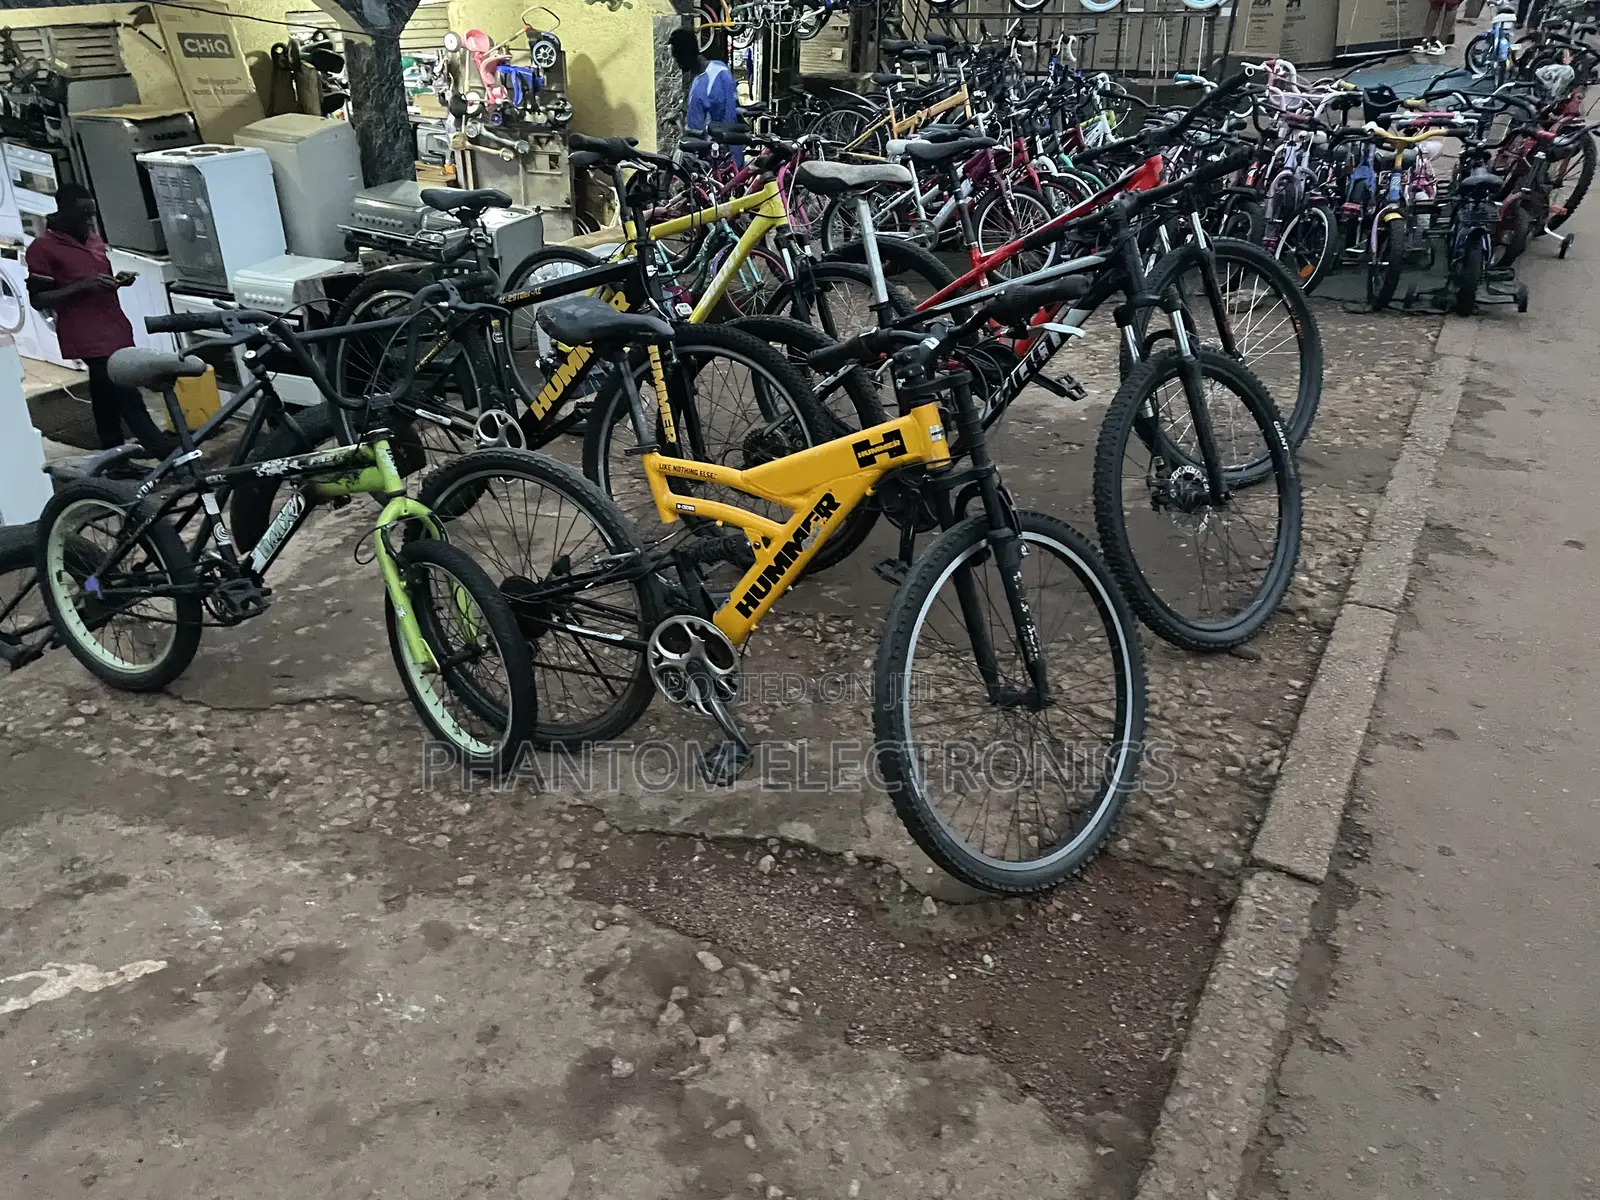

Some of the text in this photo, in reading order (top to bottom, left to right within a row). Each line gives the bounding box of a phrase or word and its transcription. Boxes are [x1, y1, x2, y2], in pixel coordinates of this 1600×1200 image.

[183, 38, 231, 55] CHiQ
[1273, 421, 1289, 451] GIANT
[857, 439, 901, 459] HUMMER
[659, 463, 671, 471] LIKE
[673, 466, 698, 476] NOTHING
